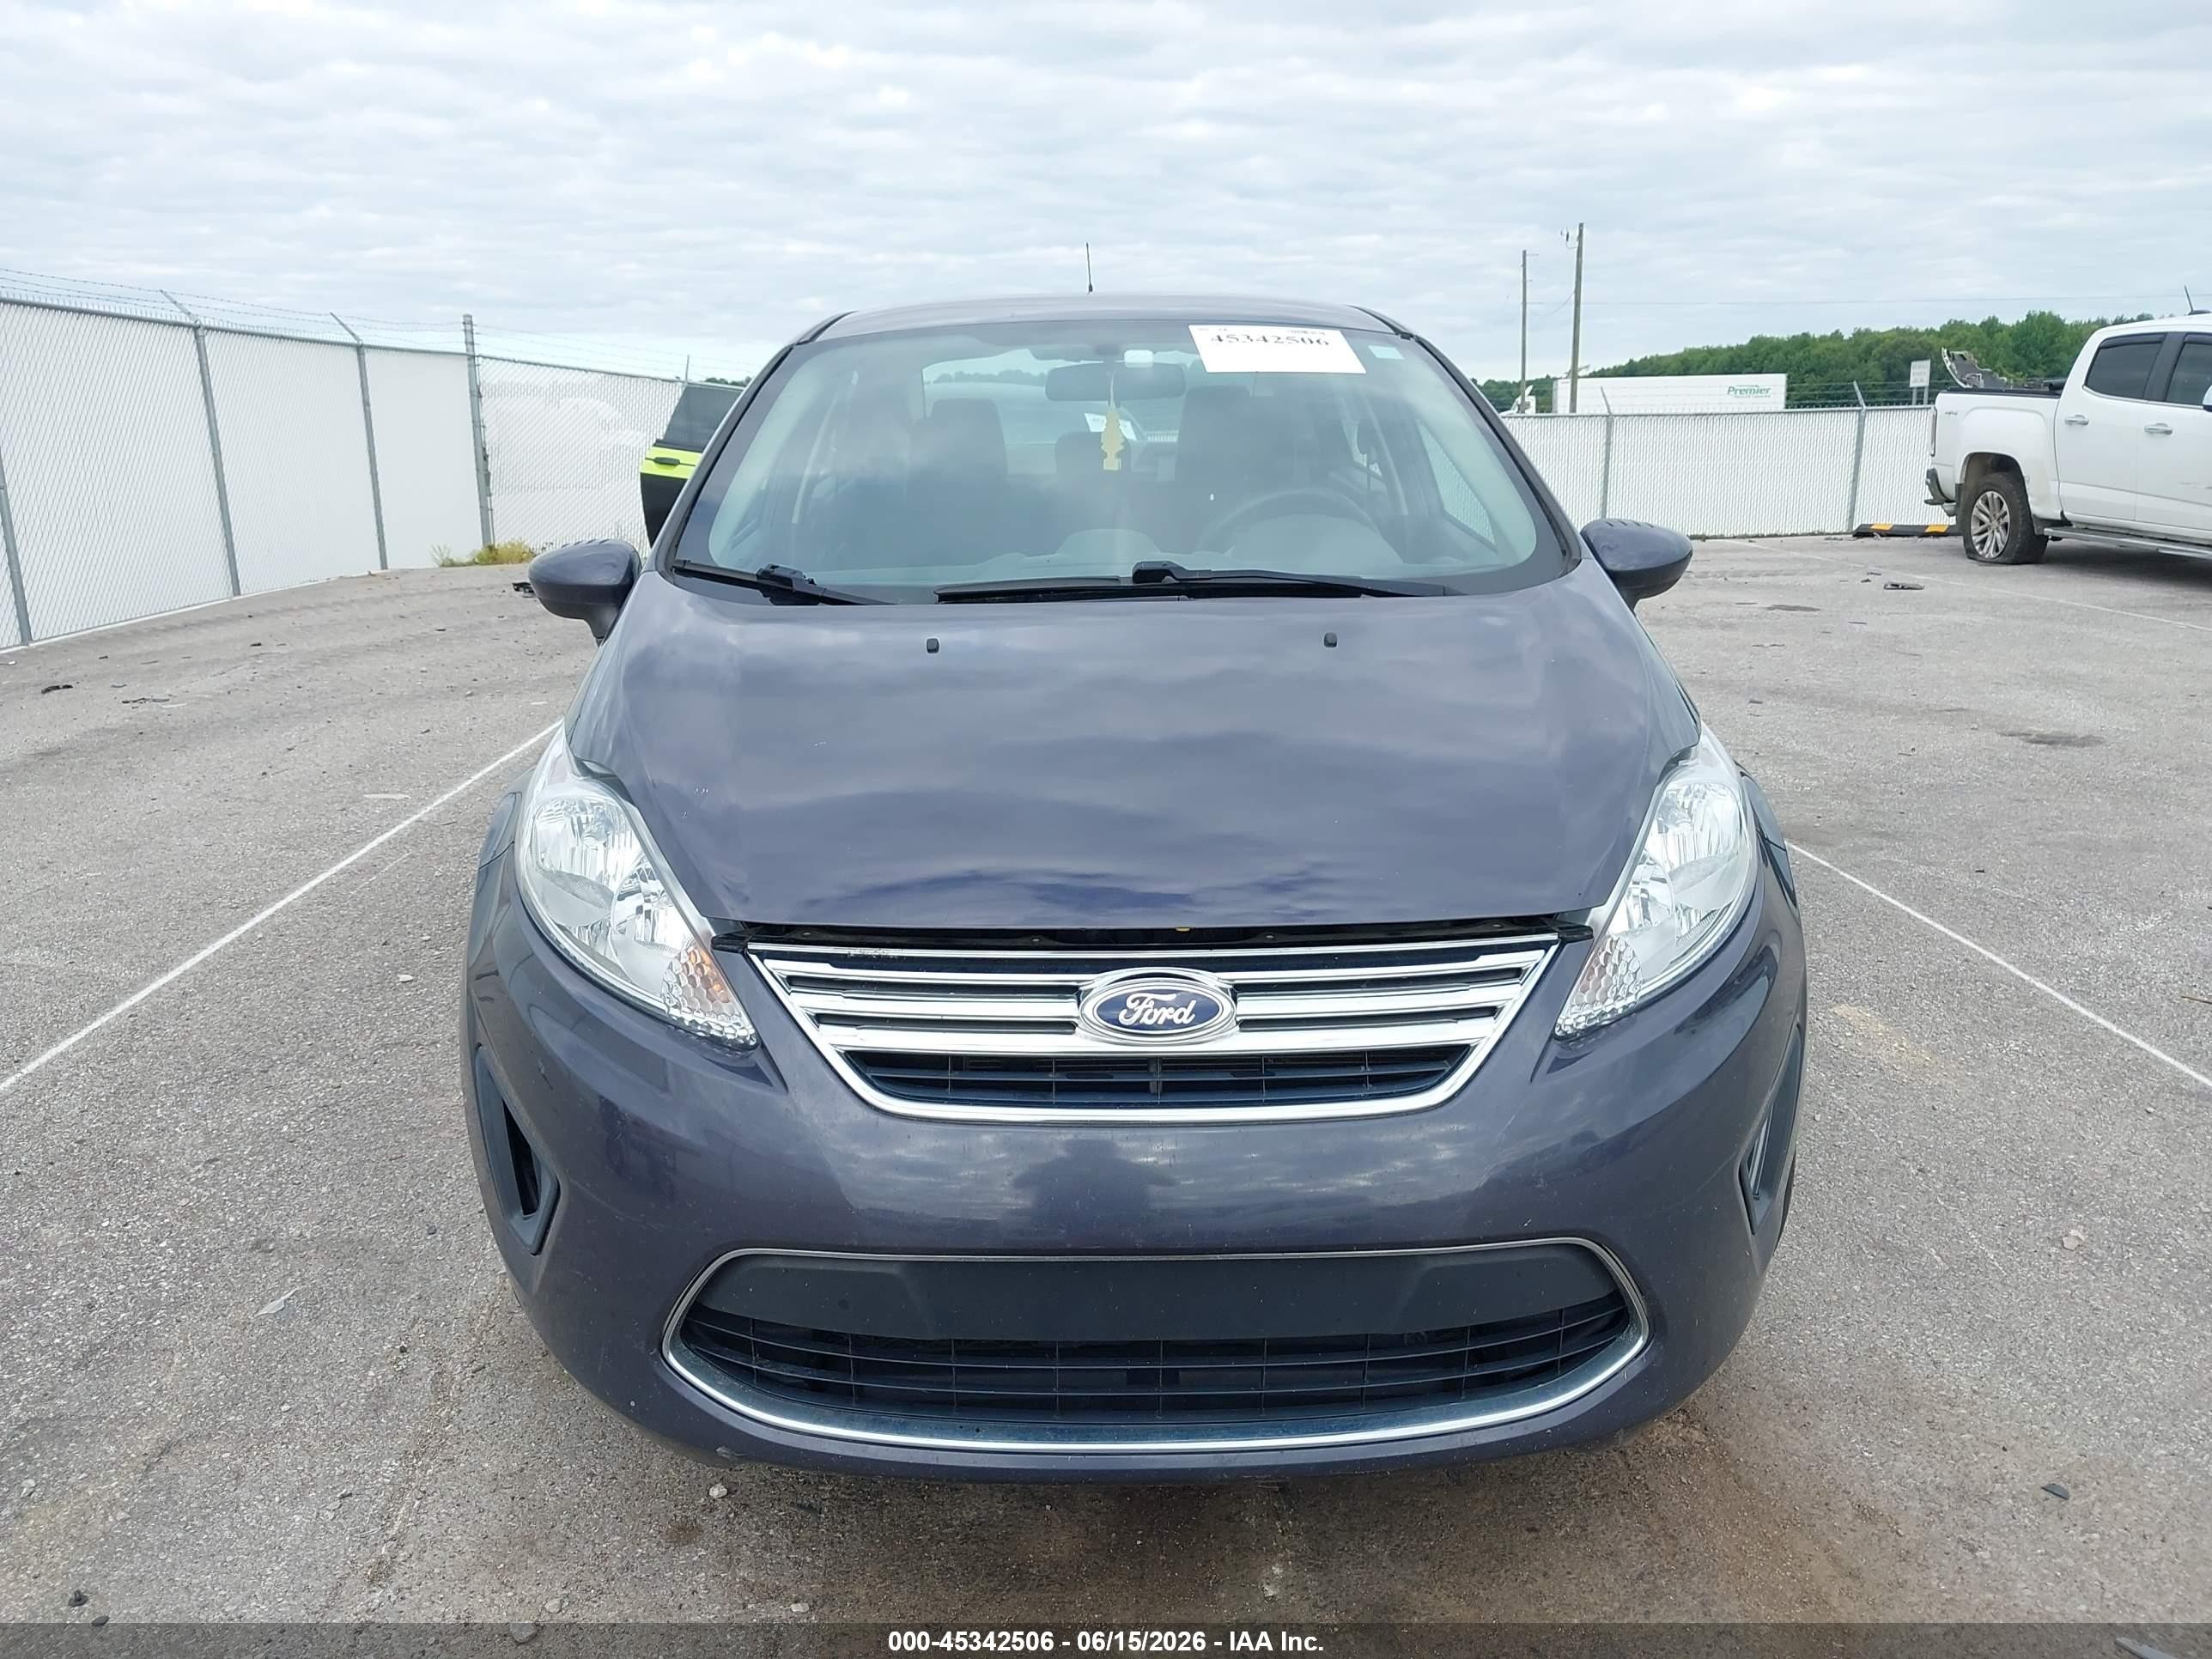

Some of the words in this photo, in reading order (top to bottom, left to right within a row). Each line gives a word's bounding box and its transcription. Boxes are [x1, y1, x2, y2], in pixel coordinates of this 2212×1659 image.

[1211, 334, 1329, 345] 45342506
[1727, 386, 1771, 396] Premier
[1118, 993, 1197, 1025] Ford
